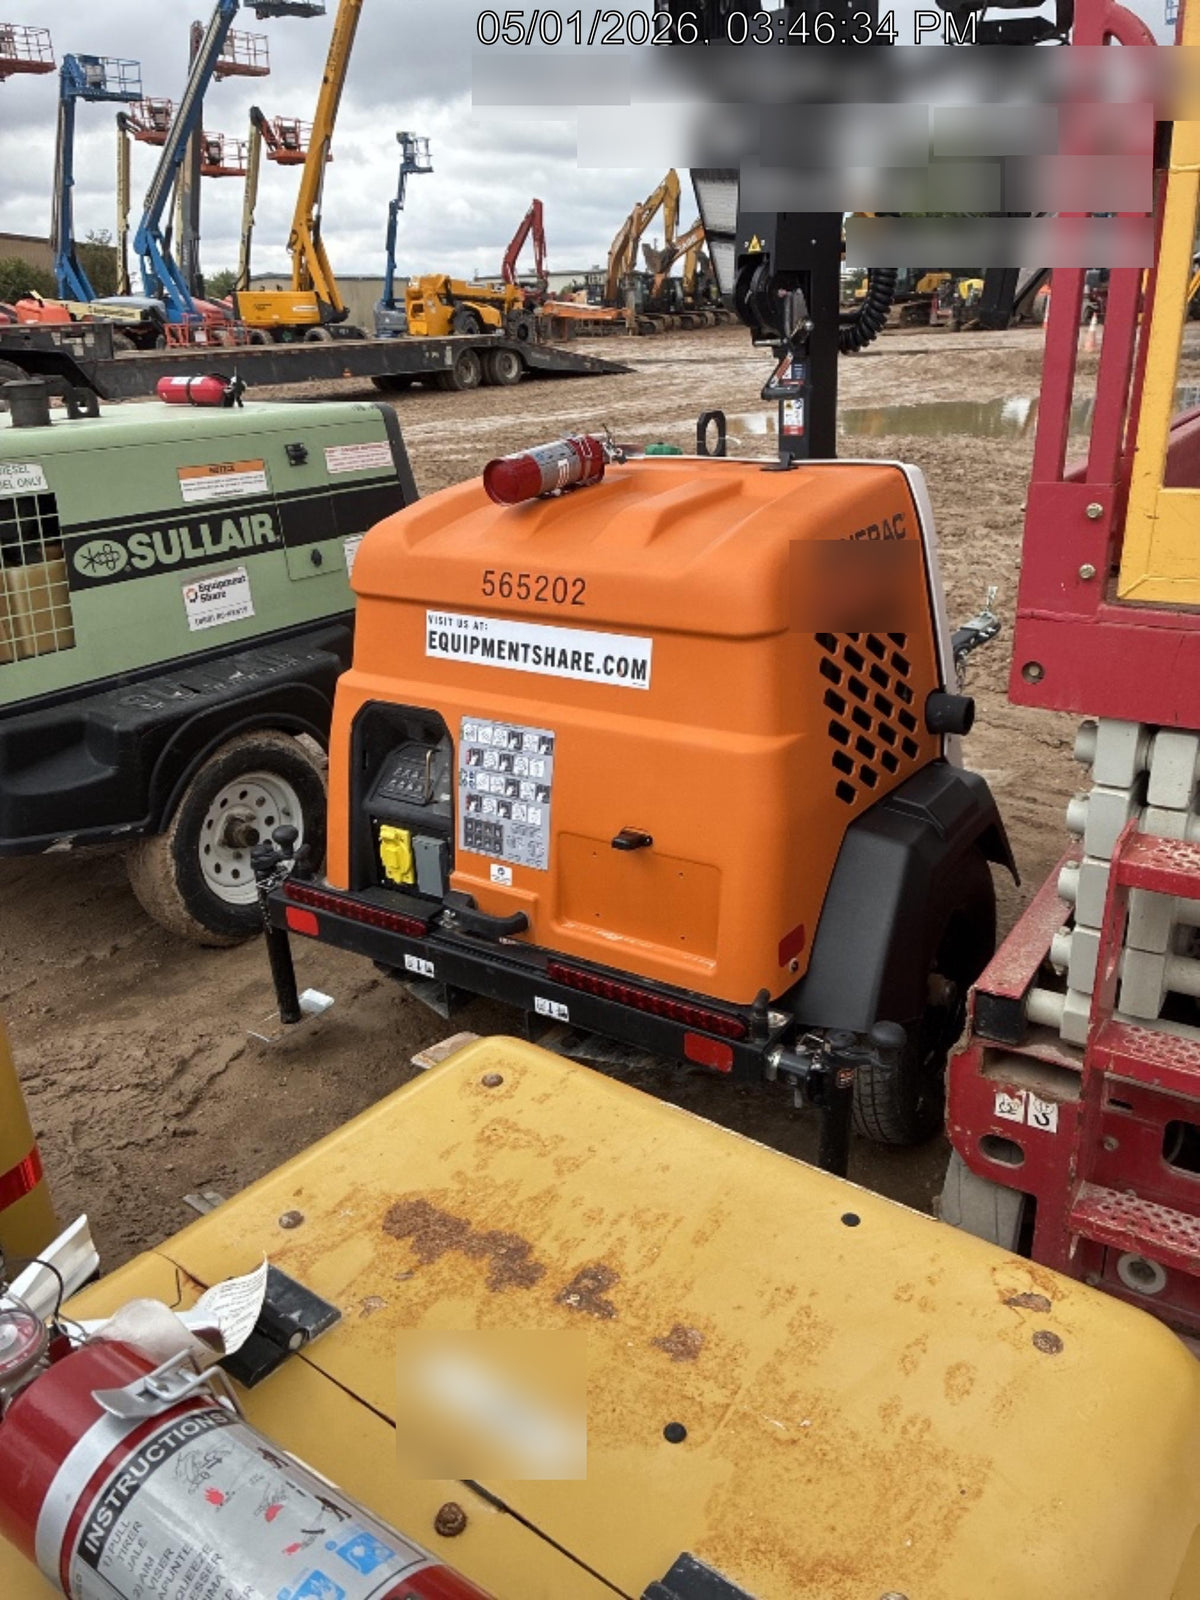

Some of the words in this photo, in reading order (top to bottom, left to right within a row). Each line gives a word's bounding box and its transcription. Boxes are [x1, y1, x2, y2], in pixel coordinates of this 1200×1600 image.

[17, 476, 42, 488] ONLY
[127, 513, 277, 570] SULLAIR
[198, 574, 246, 592] Equipment
[200, 591, 227, 603] Share
[482, 570, 586, 605] 565202
[428, 615, 453, 627] VISIT
[457, 618, 469, 629] US
[473, 620, 488, 631] AT:
[428, 630, 648, 681] EQUIPMENTSHARE.COM
[84, 1411, 228, 1555] INSTRUCTIONS
[108, 1521, 131, 1556] PULL
[116, 1520, 143, 1563] TIRER
[127, 1537, 148, 1573] JALE
[139, 1555, 155, 1585] AIM
[147, 1547, 175, 1591] VISER
[157, 1543, 194, 1600] APUNTE
